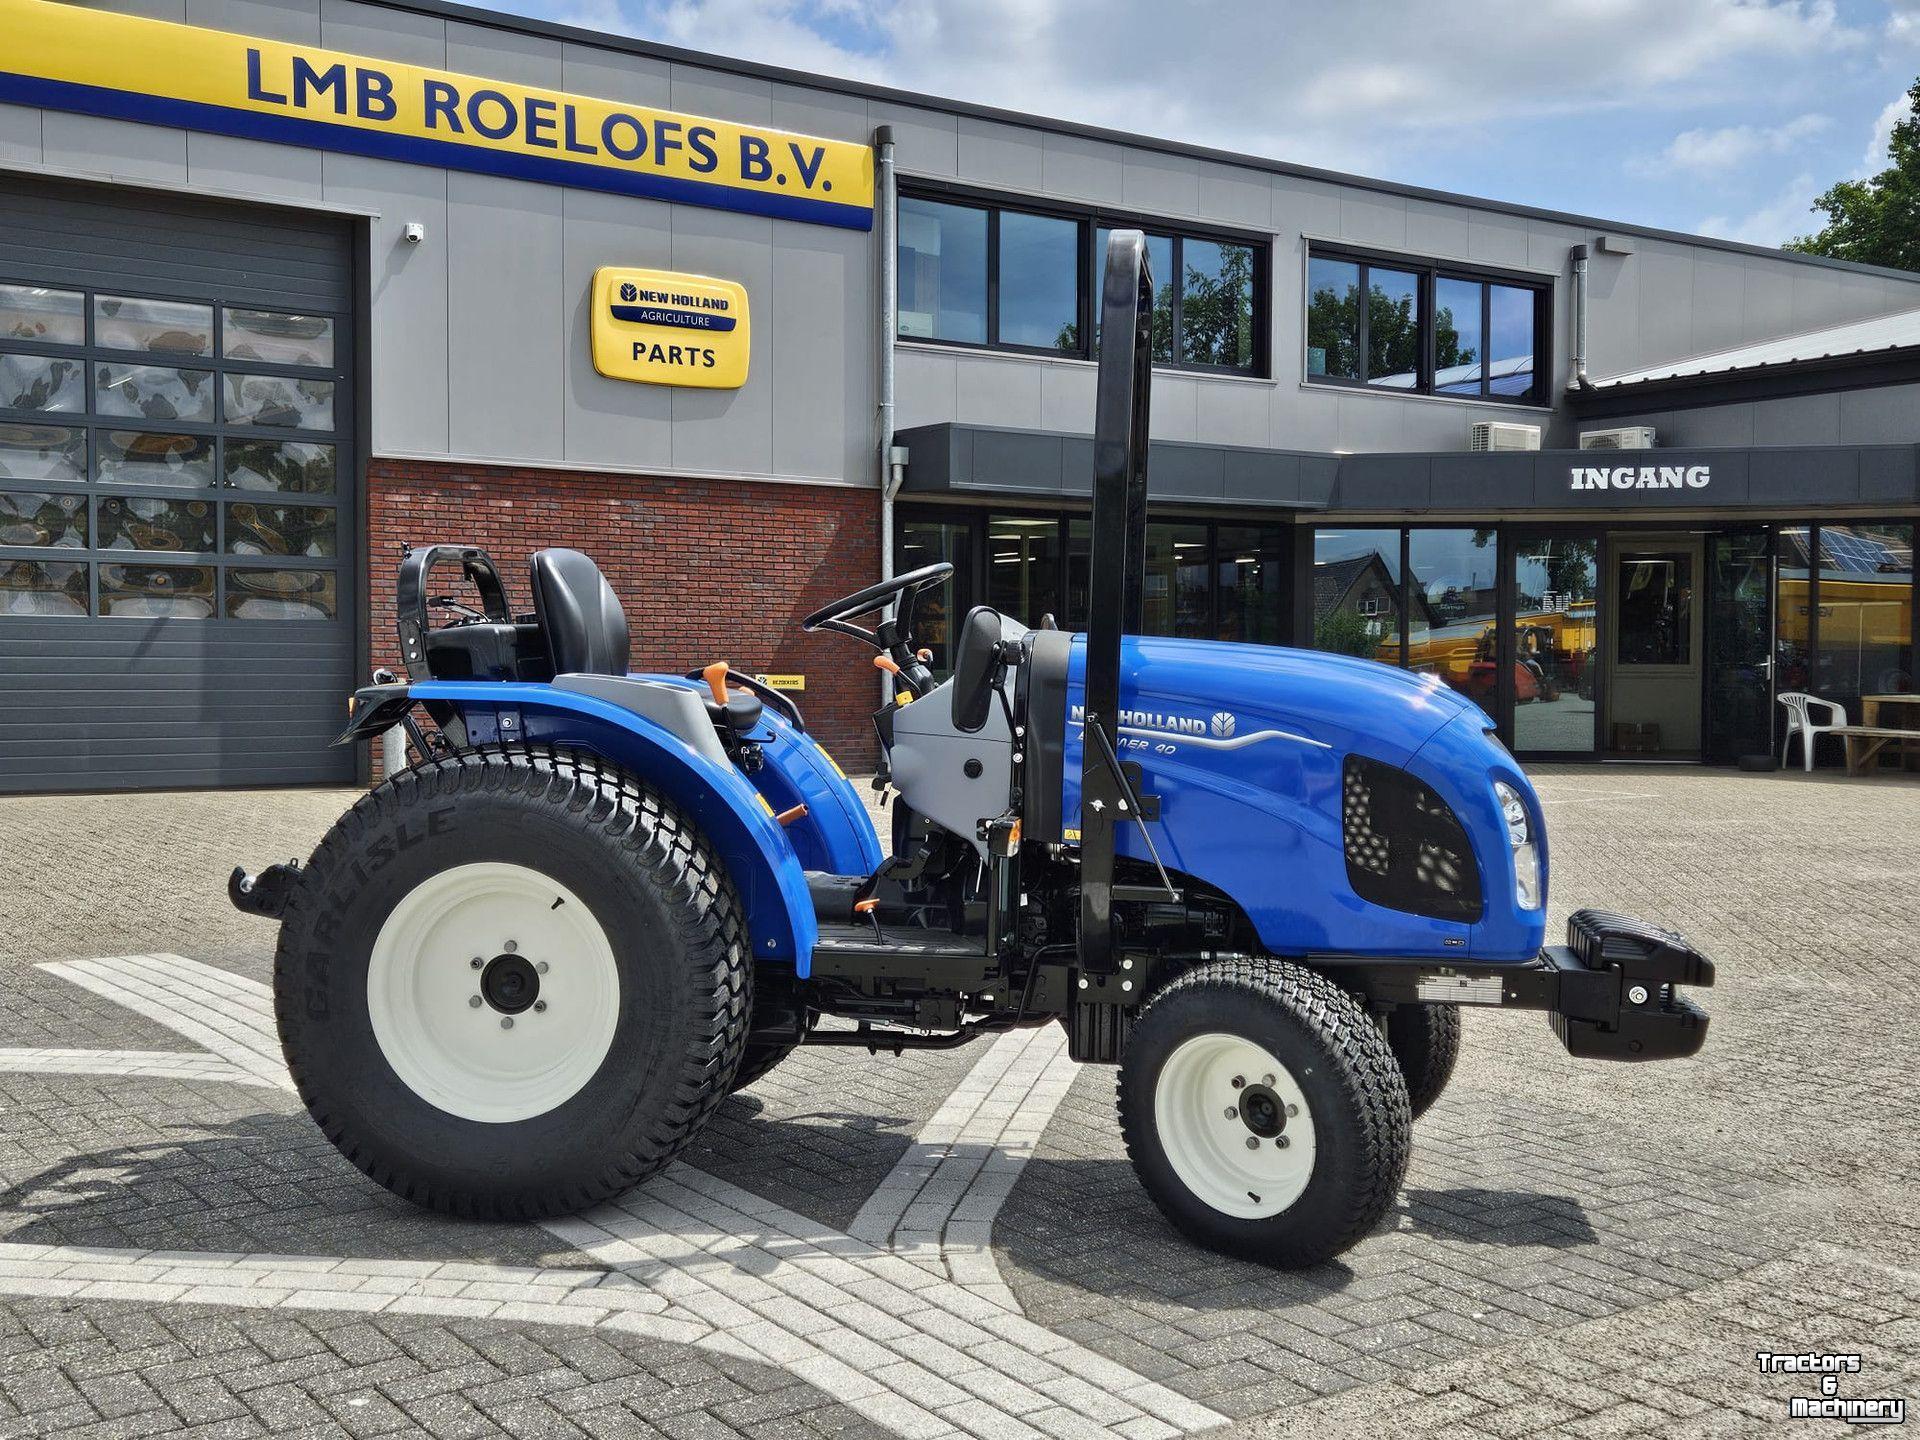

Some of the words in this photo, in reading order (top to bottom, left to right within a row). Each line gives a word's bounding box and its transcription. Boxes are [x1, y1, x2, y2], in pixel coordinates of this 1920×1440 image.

[246, 48, 397, 121] LMB
[423, 79, 718, 173] ROELOFS
[740, 135, 833, 192] B.V.
[639, 290, 669, 304] NEW
[671, 293, 729, 310] HOLLAND
[640, 310, 710, 327] AGRICULTURE
[632, 342, 715, 368] PARTS
[1571, 466, 1710, 490] INGANG
[1119, 709, 1207, 736] HOLLAND
[1154, 743, 1177, 755] 40
[303, 806, 457, 1022] CARLISLE
